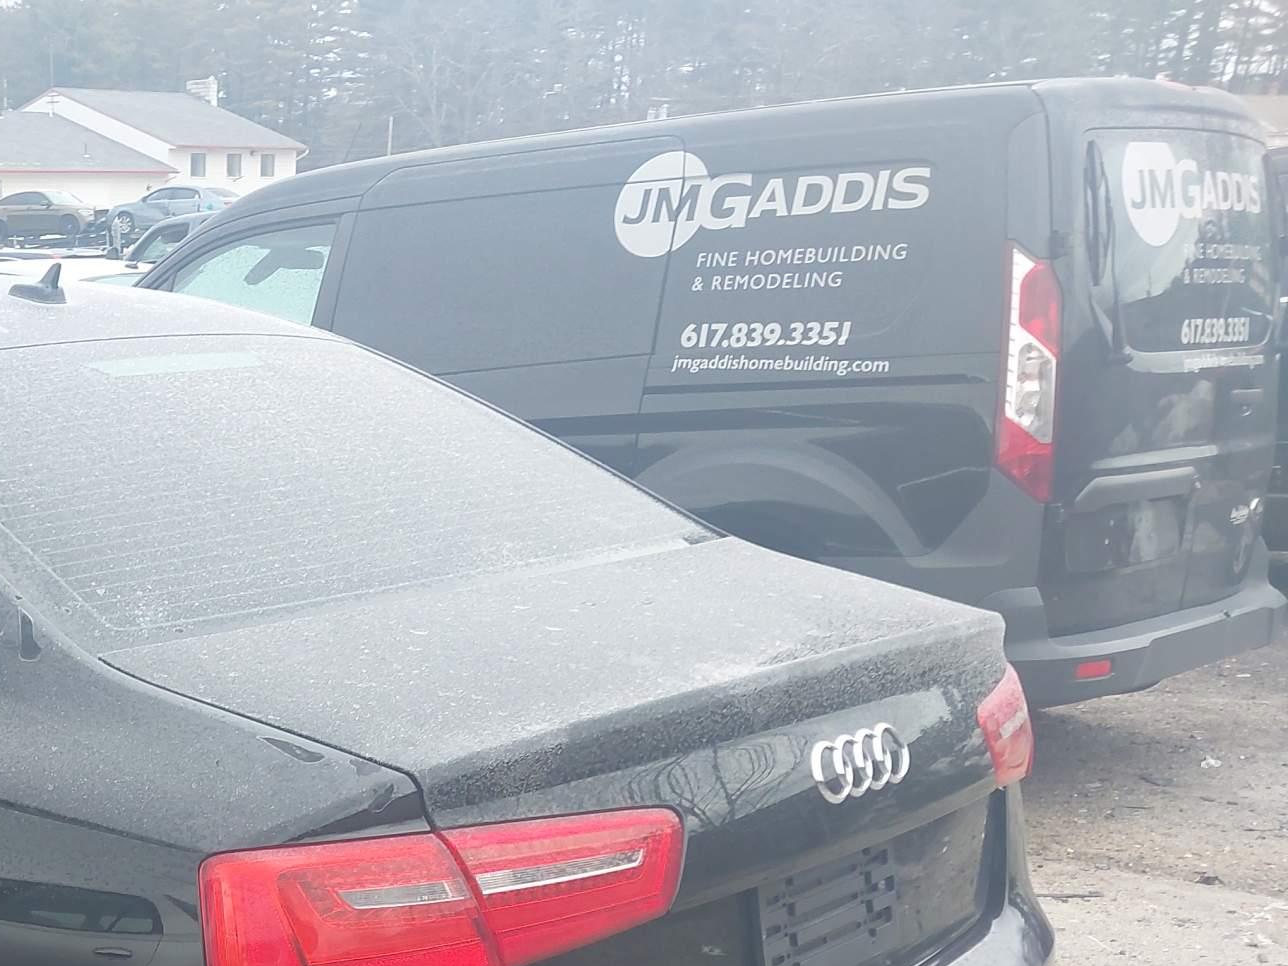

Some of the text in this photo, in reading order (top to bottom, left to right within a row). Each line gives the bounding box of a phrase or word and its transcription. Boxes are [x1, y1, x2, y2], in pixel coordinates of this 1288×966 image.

[622, 166, 932, 230] JMGADDIS
[1130, 158, 1262, 219] JMGADDIS
[696, 243, 909, 268] FINE HOMEBUILDING
[691, 271, 843, 292] & REMODELING
[680, 320, 852, 349] 617.839.3351
[1181, 317, 1250, 344] 617.839.3351
[670, 354, 890, 376] jmgaddishomebuilding.com
